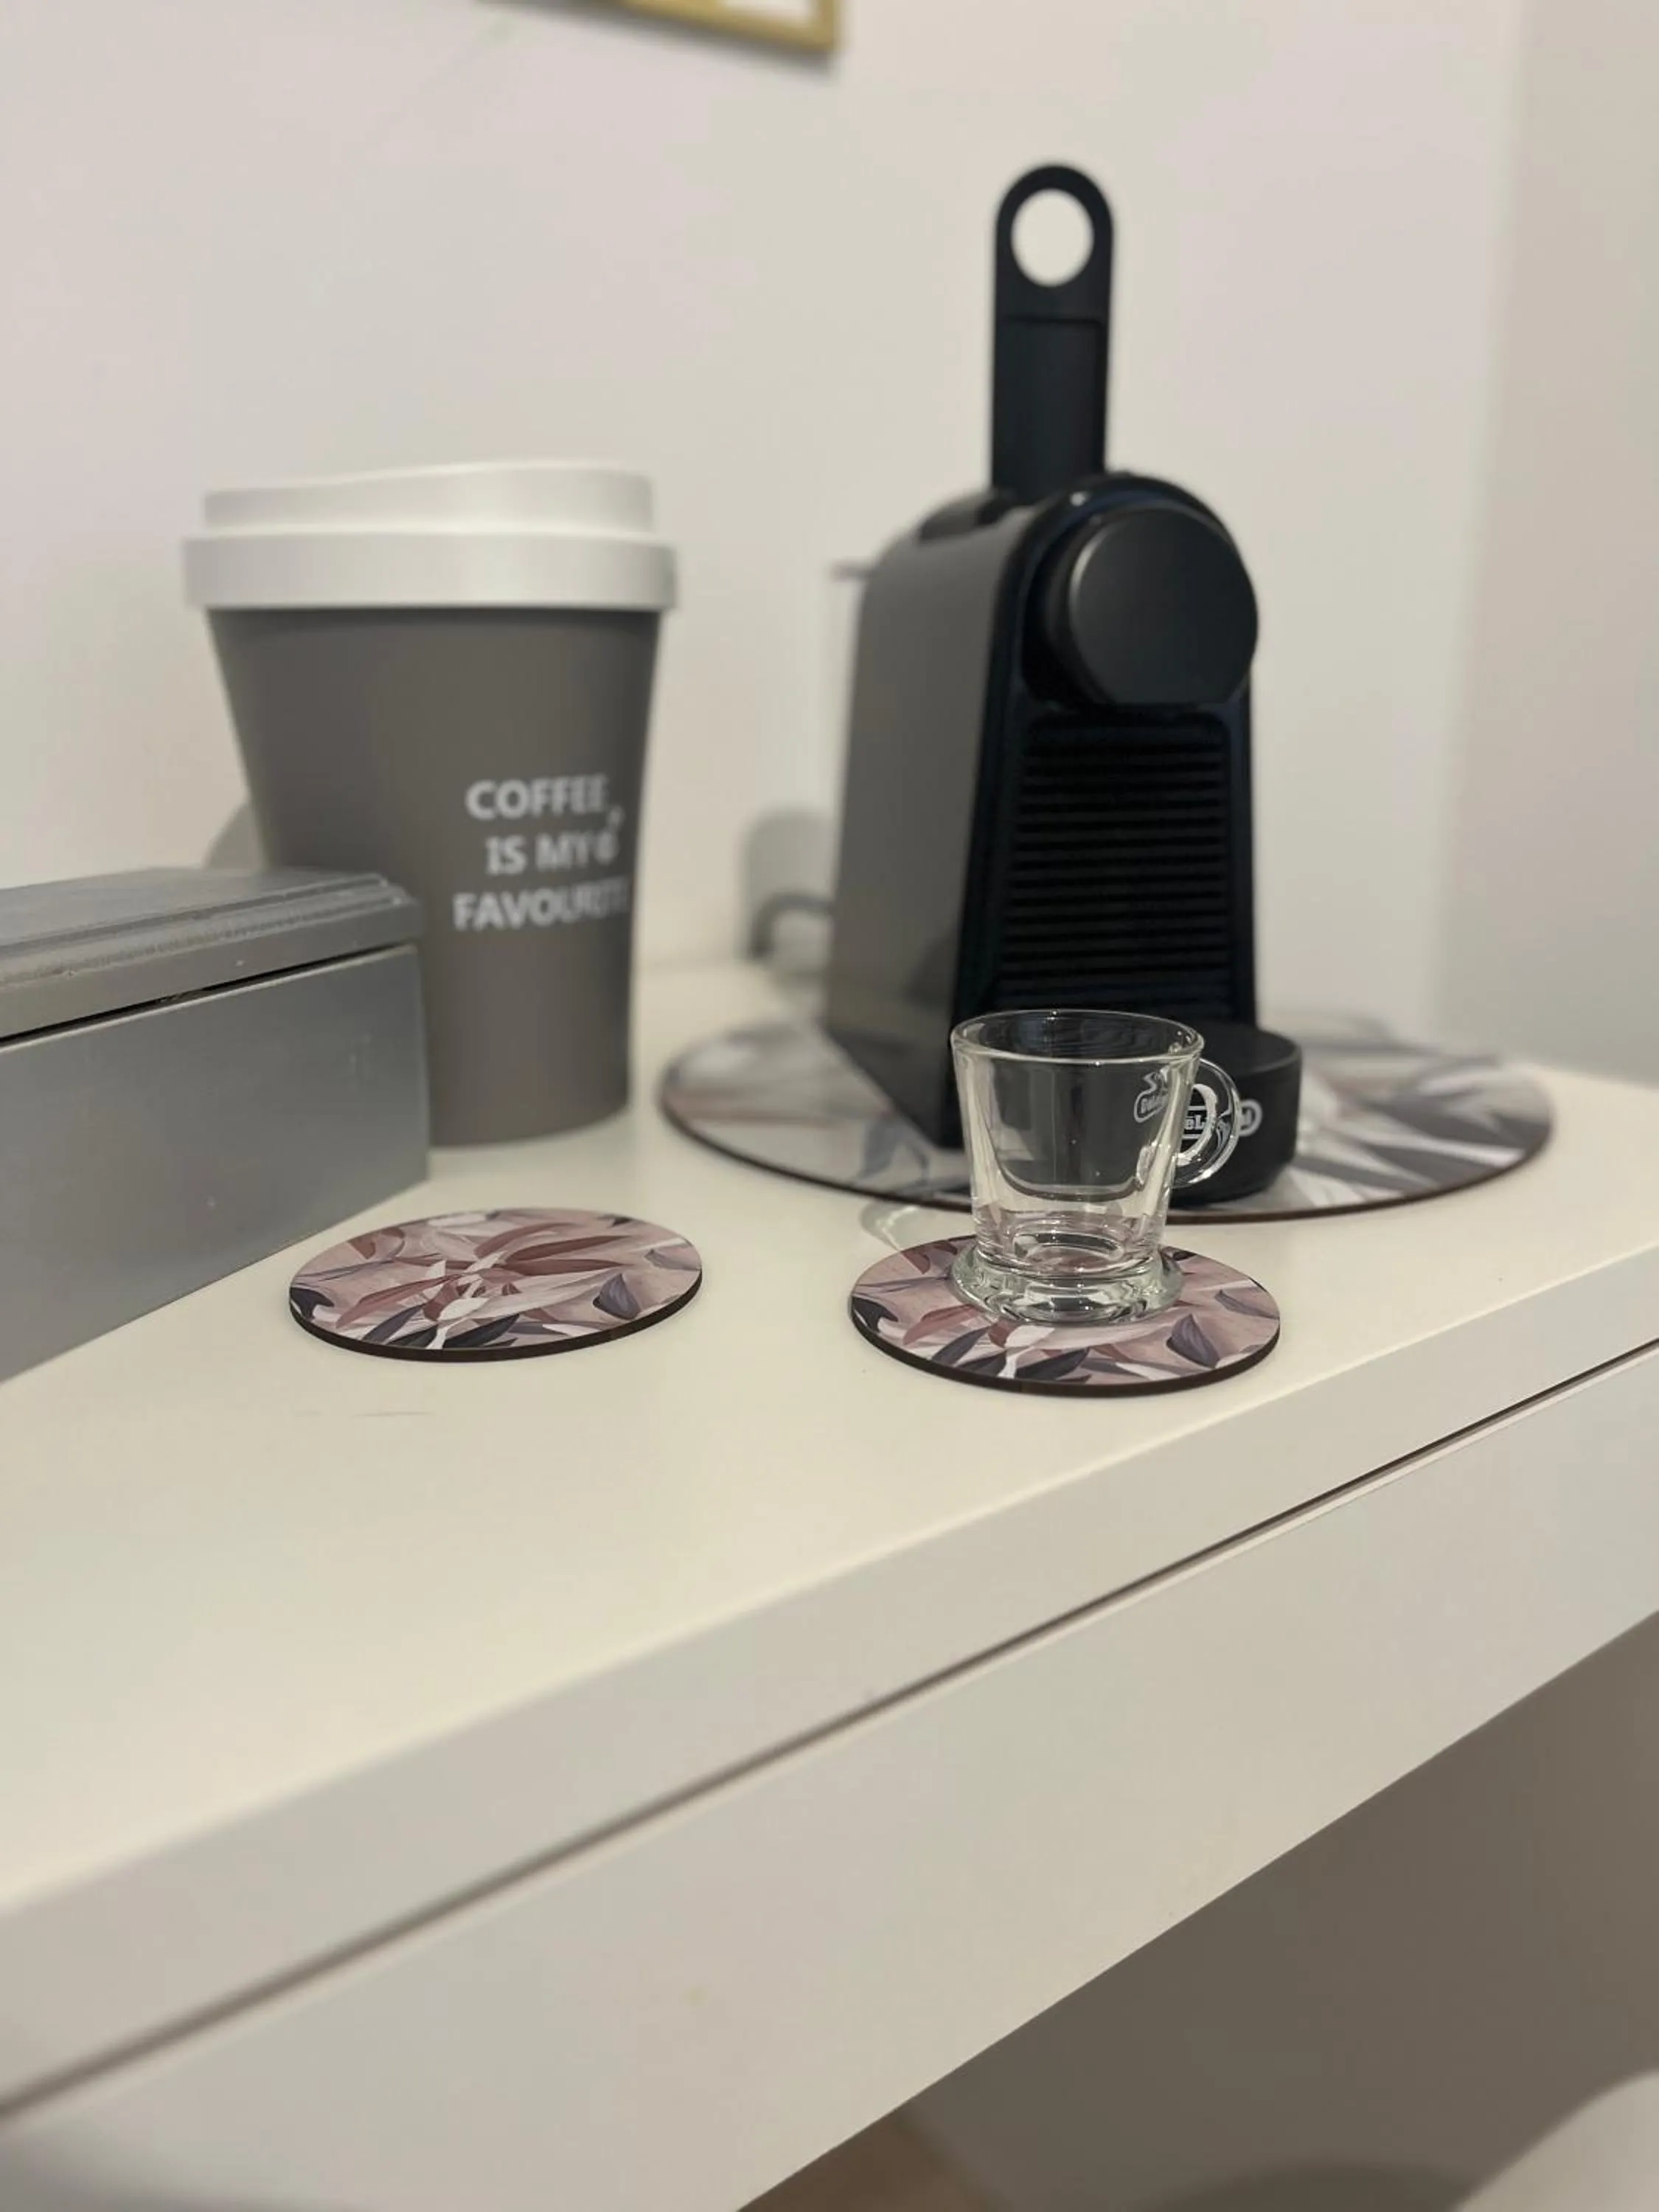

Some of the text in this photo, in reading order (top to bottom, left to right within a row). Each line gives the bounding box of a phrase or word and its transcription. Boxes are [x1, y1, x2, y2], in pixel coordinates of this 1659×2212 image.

[465, 773, 608, 821] COFFEE
[484, 830, 592, 875] IS MY
